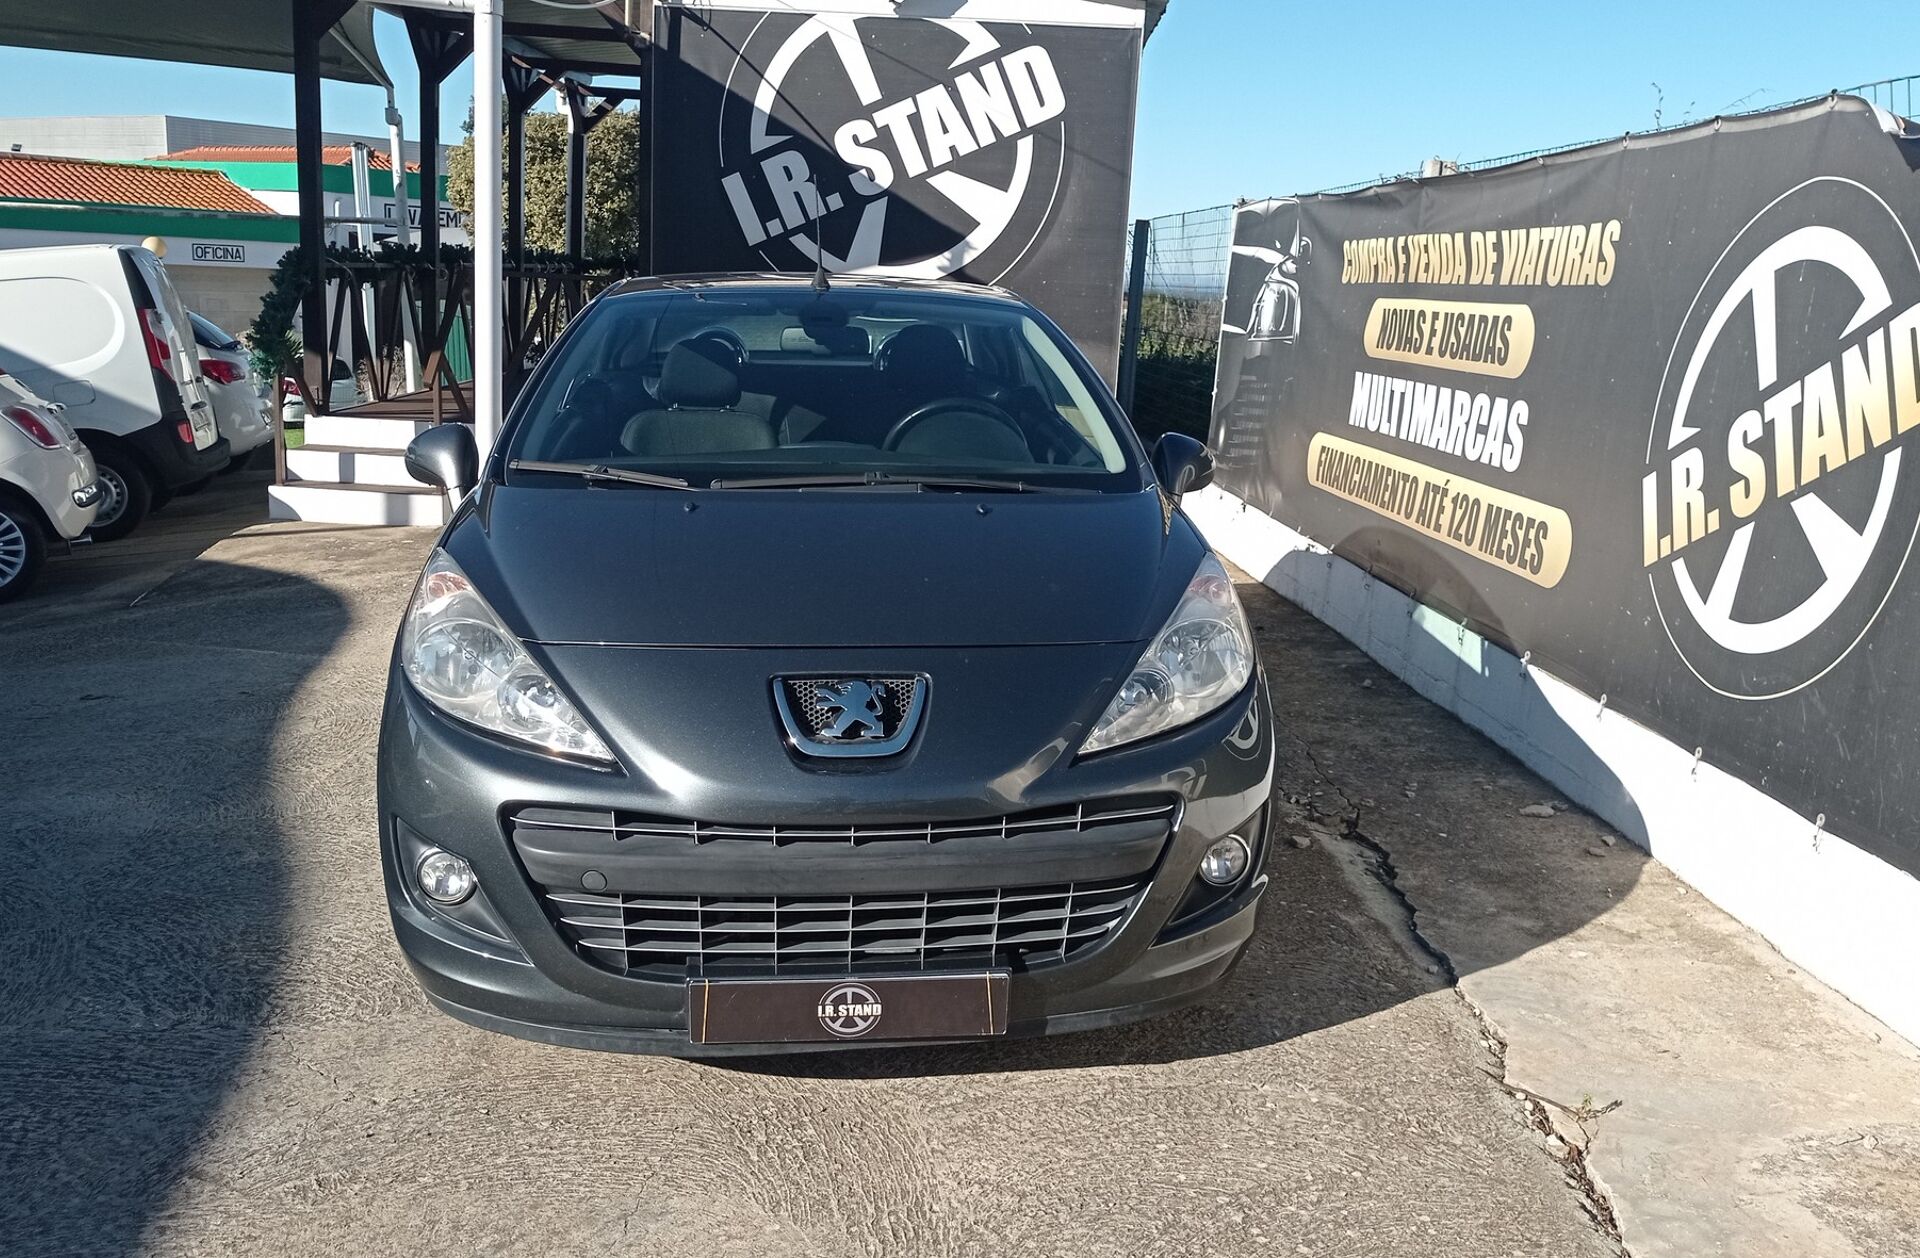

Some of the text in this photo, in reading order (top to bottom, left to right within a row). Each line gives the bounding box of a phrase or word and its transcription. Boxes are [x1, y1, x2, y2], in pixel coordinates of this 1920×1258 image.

[721, 45, 1066, 247] I.R. STAND
[195, 246, 242, 260] OFICINA
[1342, 219, 1621, 287] COMPRA E VENDA DE VIATURAS
[1376, 308, 1513, 367] NOVAS E USADAS
[1348, 371, 1530, 473] MULTIMARCAS
[1642, 302, 1920, 568] I.R. STAND
[1316, 445, 1549, 576] FINANCIAMENTO ATÉ 120 MESES
[817, 1003, 882, 1017] I.R. STAND
